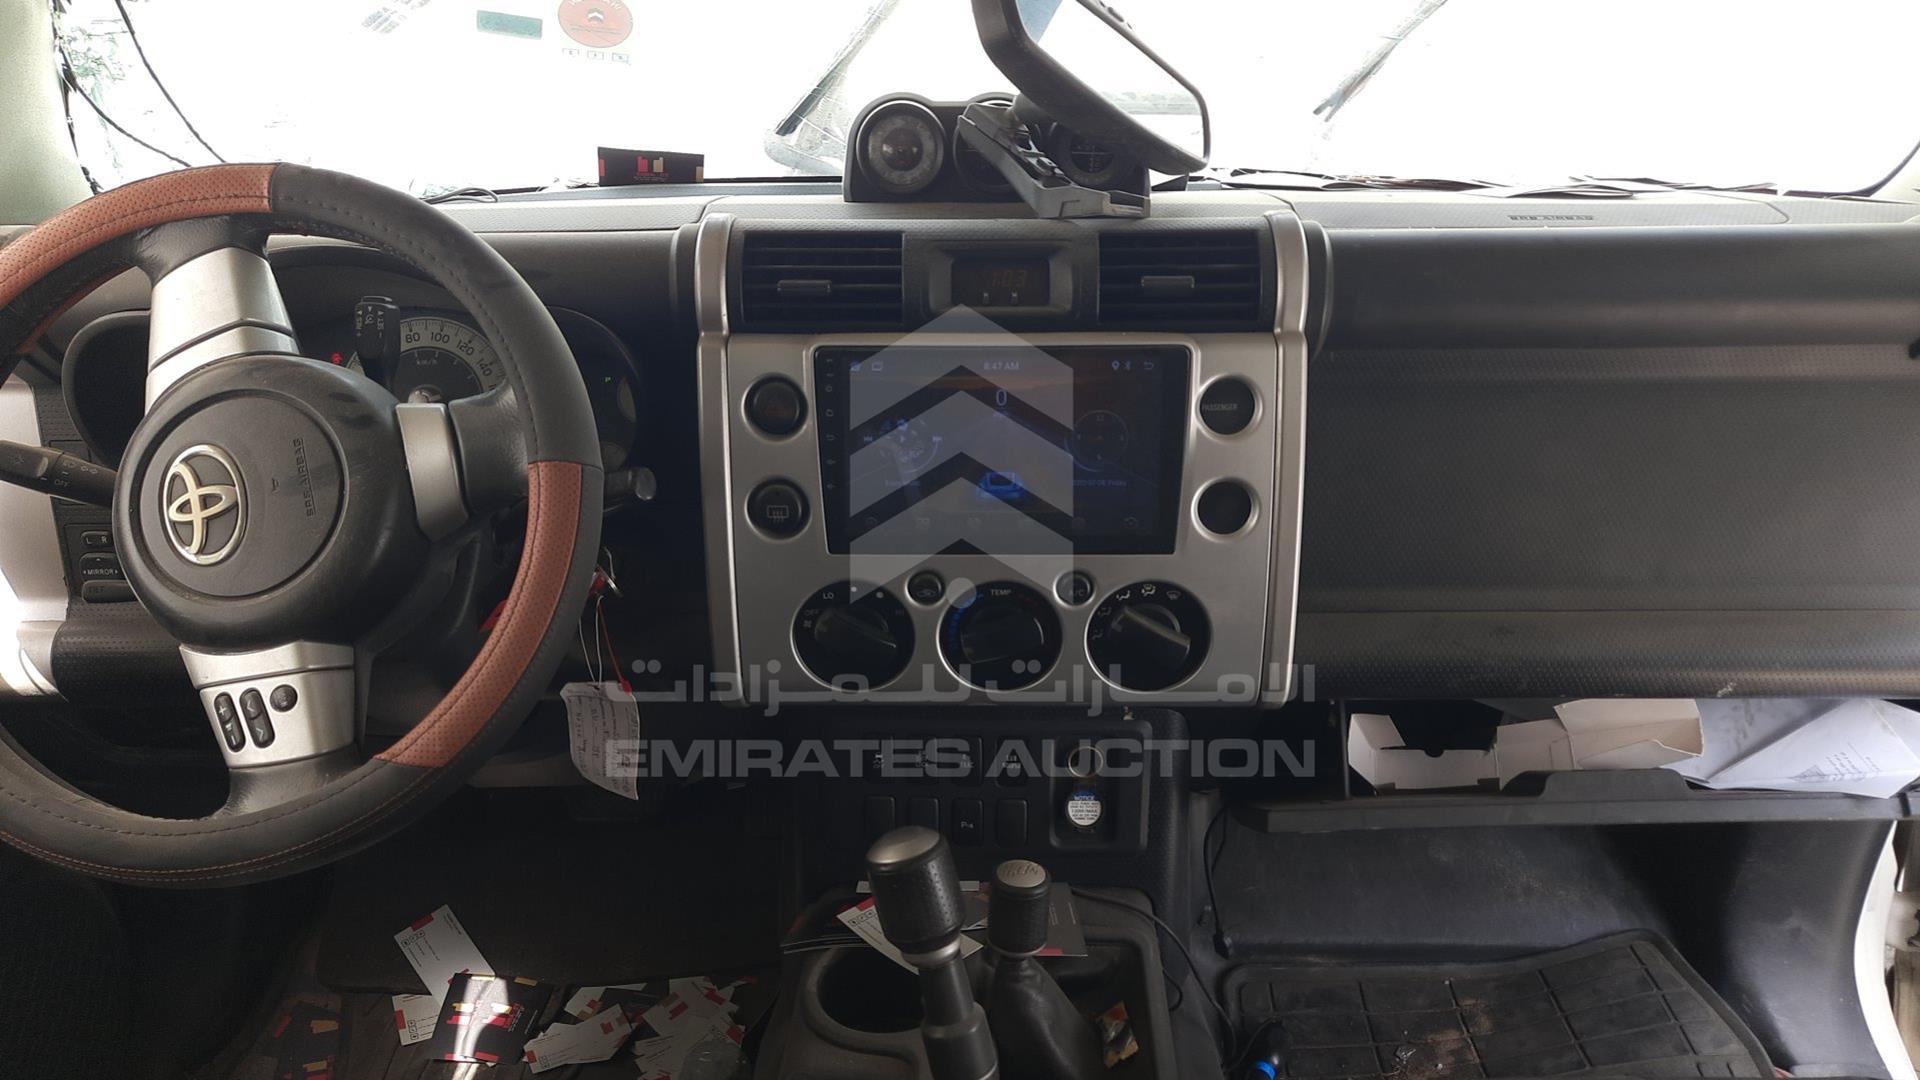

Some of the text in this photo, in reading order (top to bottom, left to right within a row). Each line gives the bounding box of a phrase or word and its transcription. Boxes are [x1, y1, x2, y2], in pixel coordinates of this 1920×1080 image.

[405, 332, 421, 344] 80
[430, 332, 450, 345] 100
[456, 340, 474, 356] 120
[416, 358, 438, 366] km/h
[477, 358, 492, 377] 140
[1003, 360, 1020, 371] AM
[995, 388, 1008, 407] 0
[87, 568, 114, 576] MIRROR
[822, 591, 835, 600] LO
[990, 588, 1012, 597] TEMP
